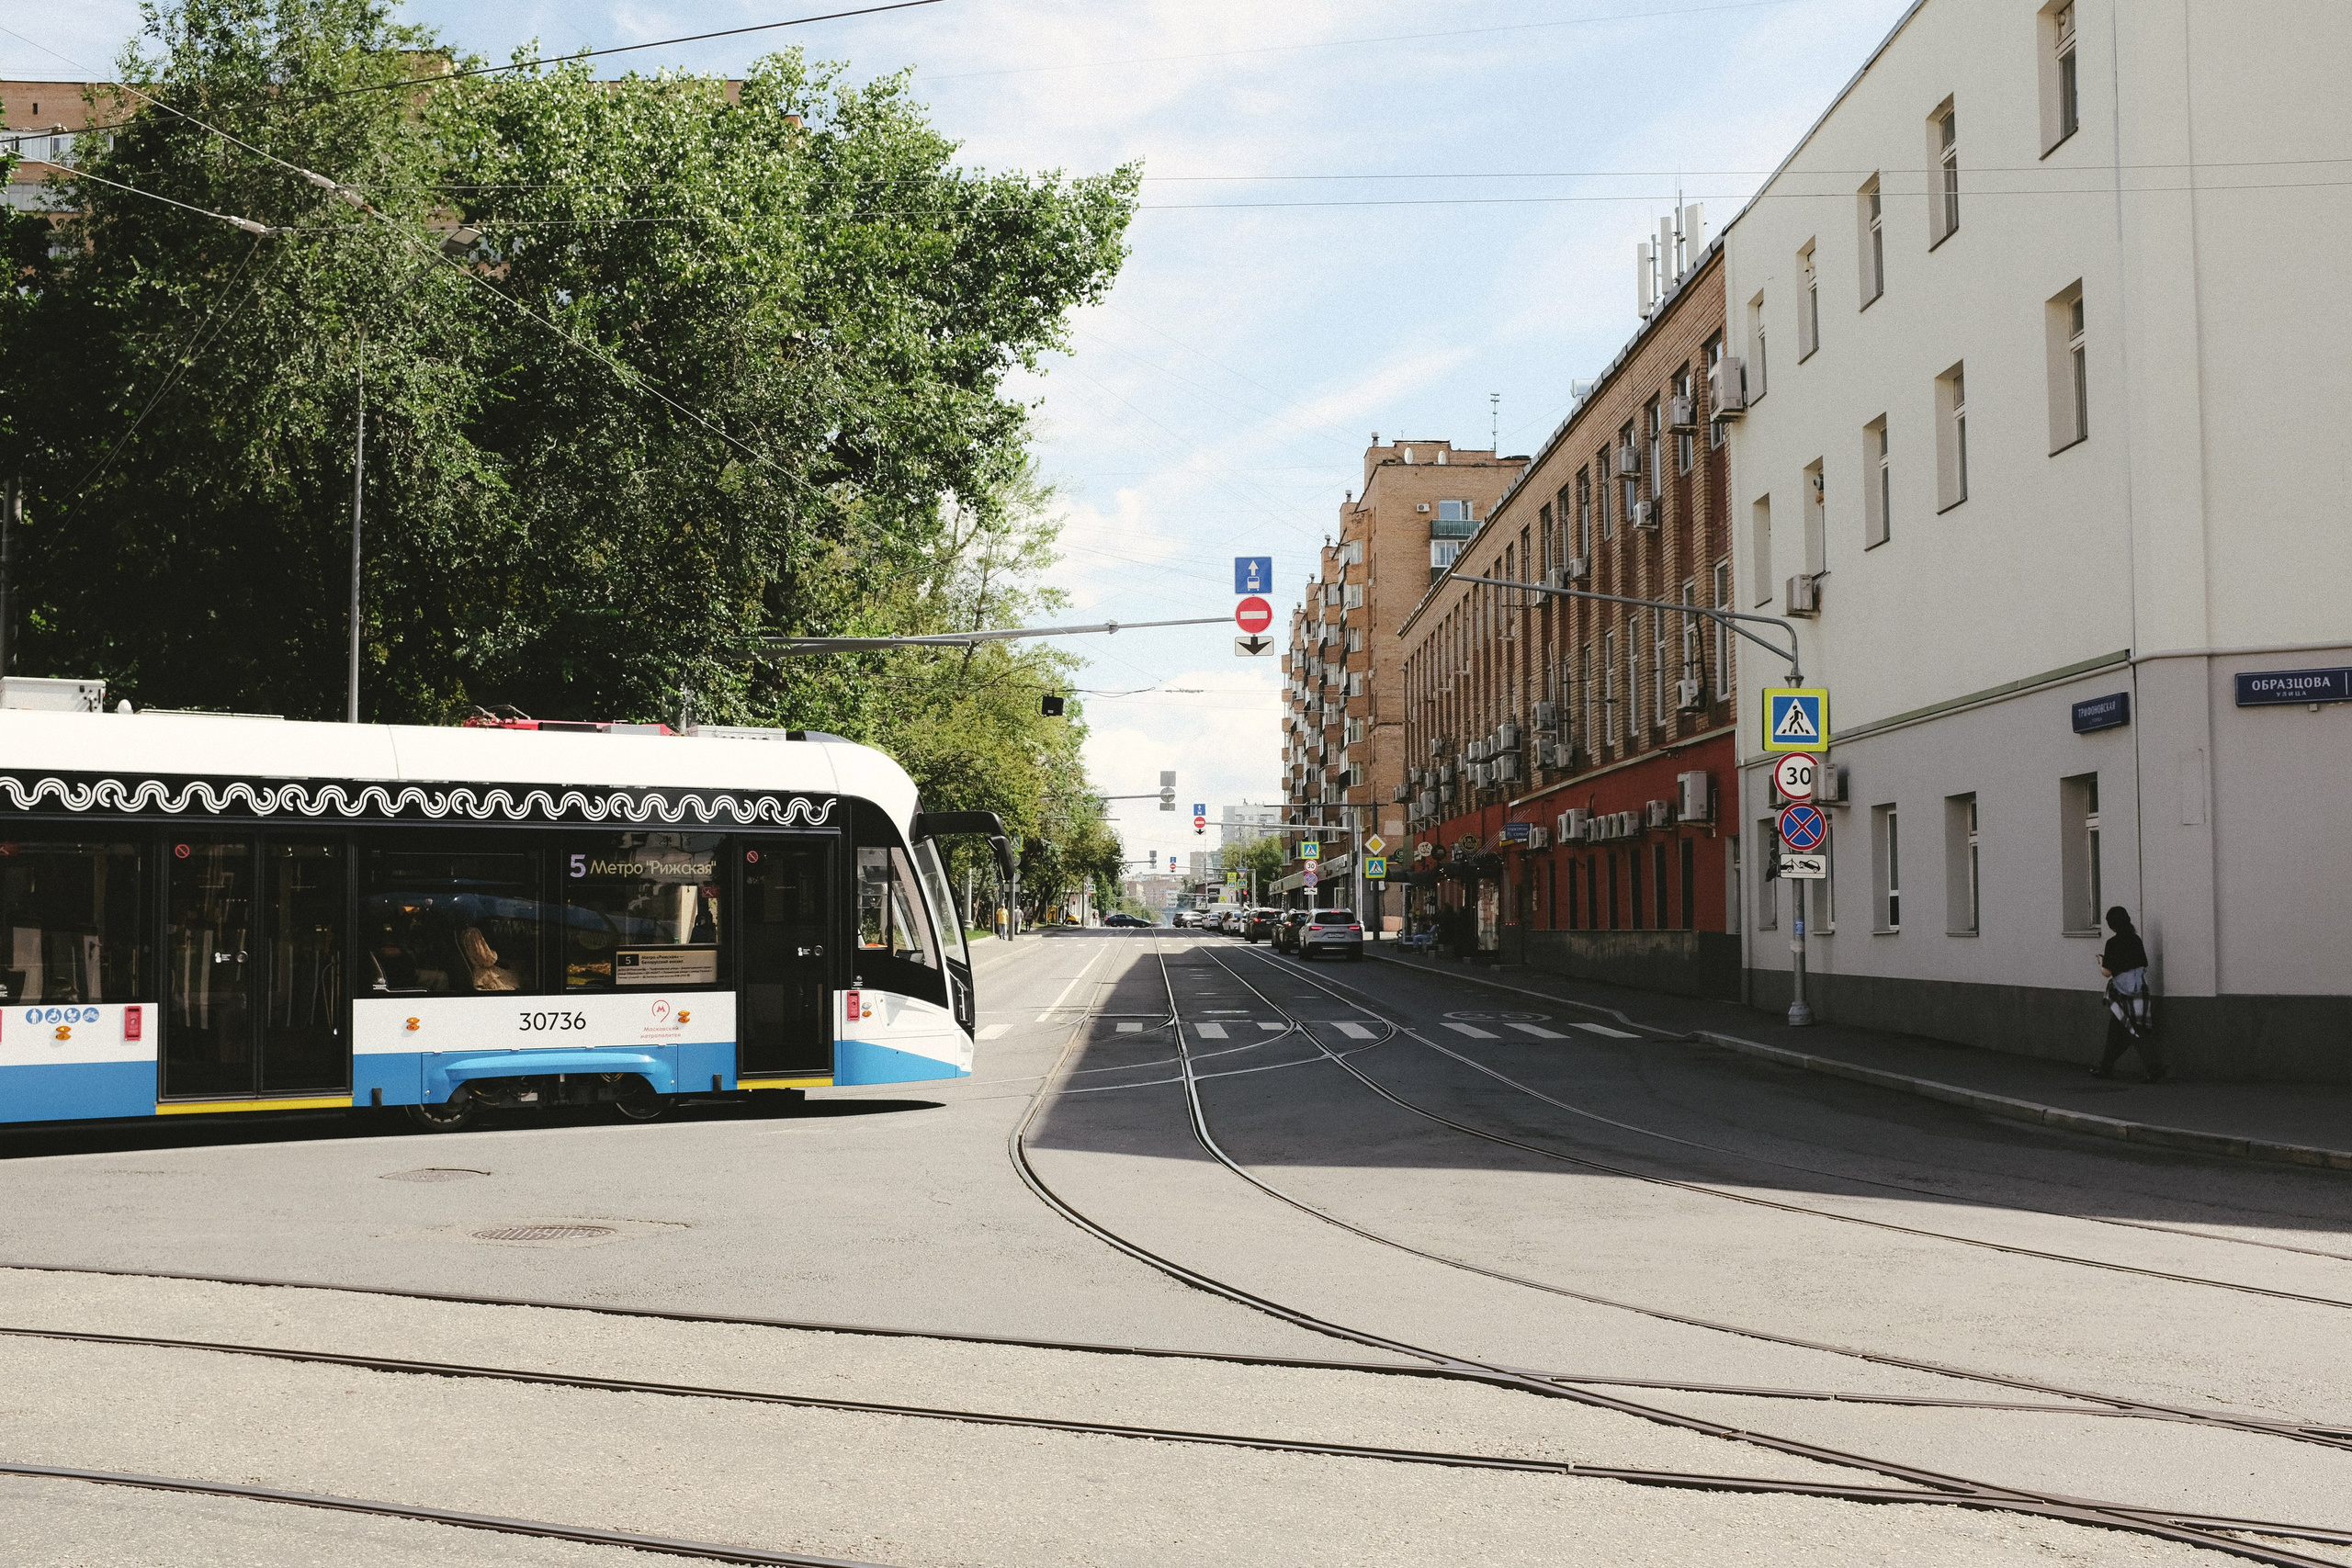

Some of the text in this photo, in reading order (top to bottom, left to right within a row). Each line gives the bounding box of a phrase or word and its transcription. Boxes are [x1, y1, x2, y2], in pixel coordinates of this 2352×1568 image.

[2251, 676, 2331, 691] ОБРАЗЦОВА
[1786, 766, 1811, 785] 30
[570, 853, 717, 878] 5 Метро "Рижская"
[625, 956, 631, 964] 5
[519, 1011, 586, 1031] 30736
